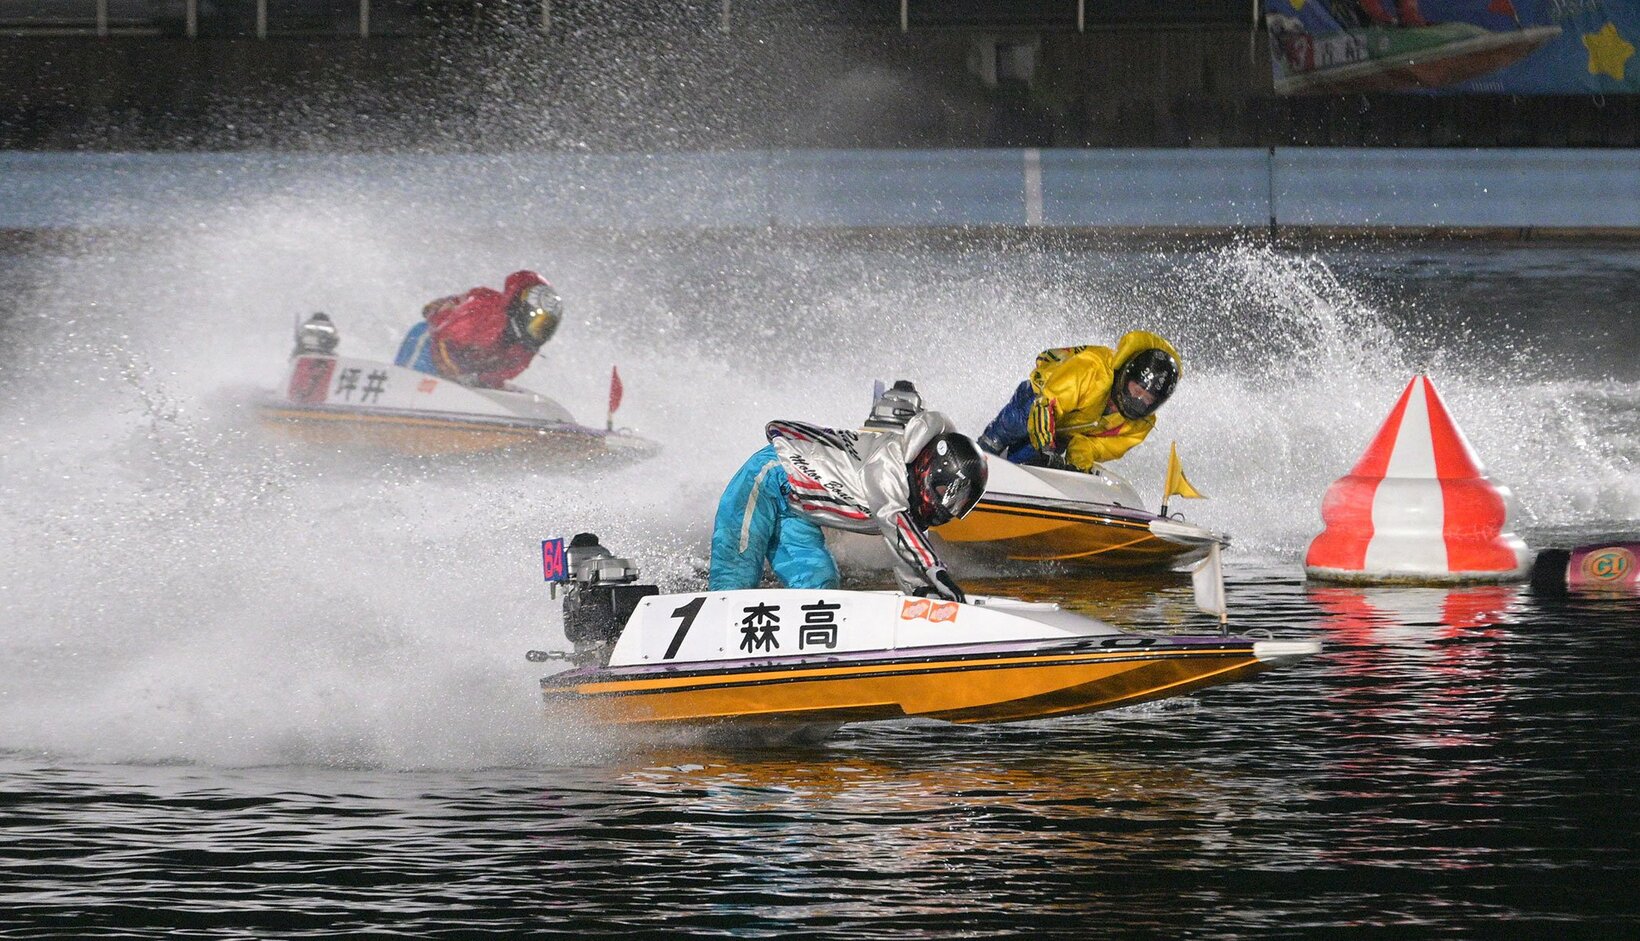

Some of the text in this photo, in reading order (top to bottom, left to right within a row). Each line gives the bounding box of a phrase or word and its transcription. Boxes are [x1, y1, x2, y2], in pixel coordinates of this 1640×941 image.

[335, 367, 388, 404] 坪井
[543, 541, 563, 581] 64
[663, 596, 707, 660] 1
[739, 599, 842, 653] 森高
